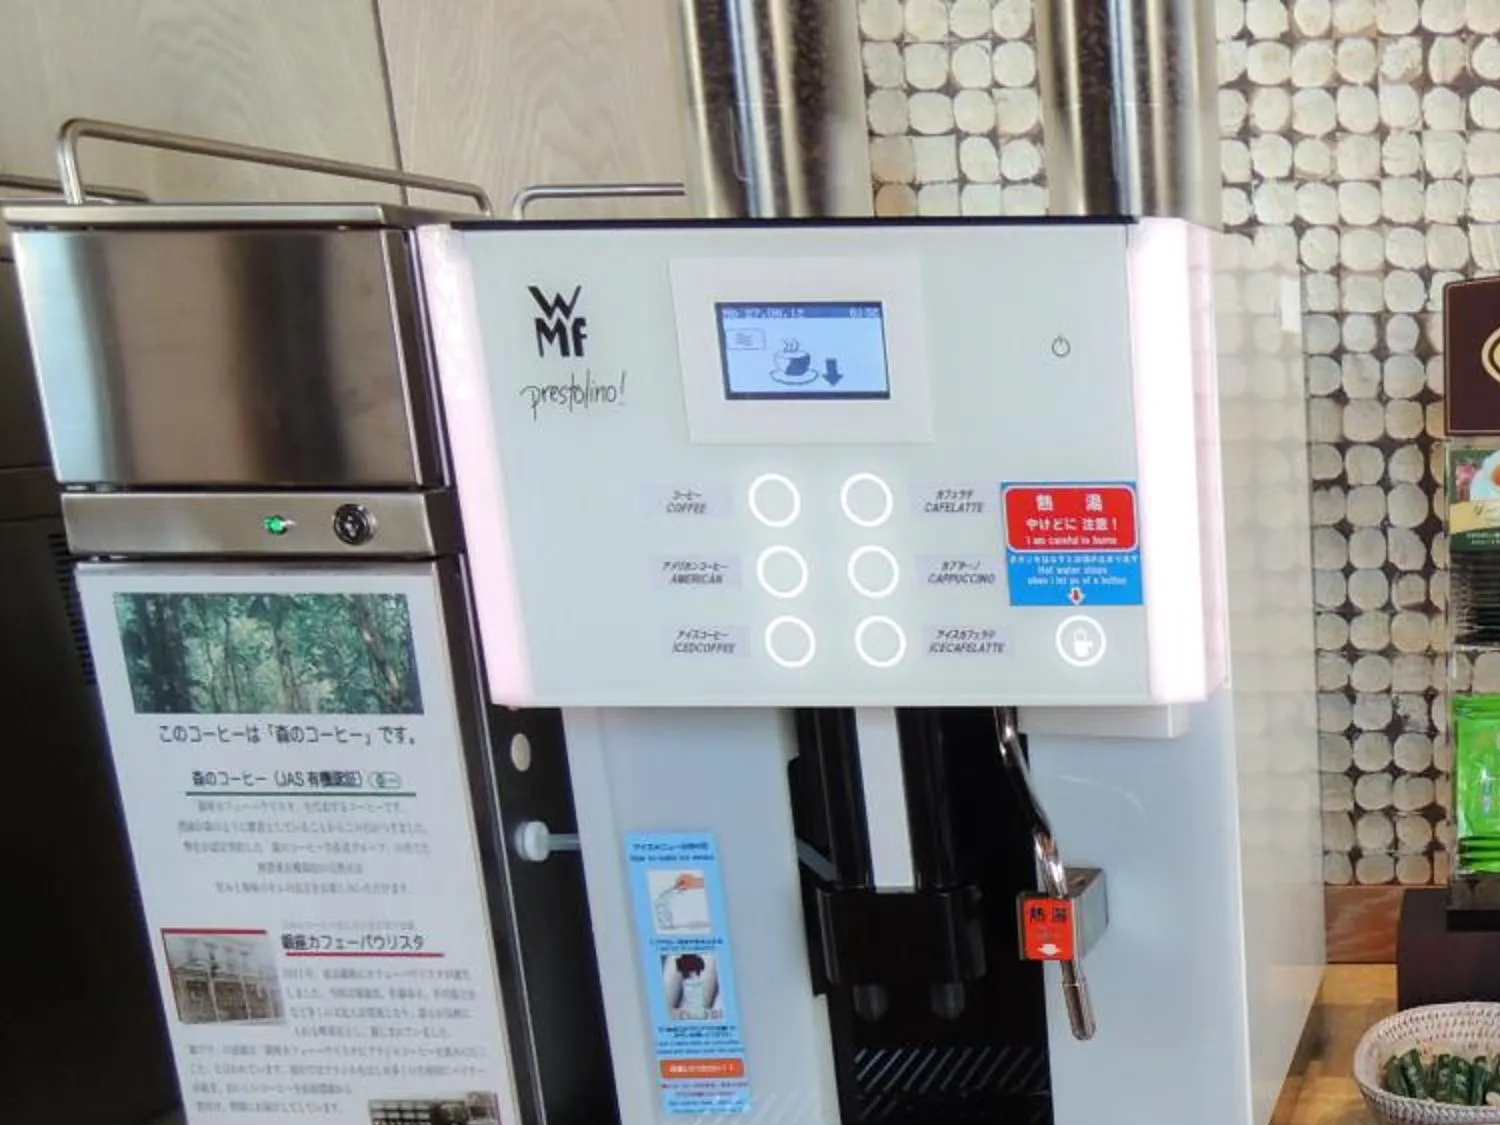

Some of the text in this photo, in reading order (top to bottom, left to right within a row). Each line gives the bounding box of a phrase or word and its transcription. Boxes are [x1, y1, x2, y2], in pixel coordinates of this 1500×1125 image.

[527, 285, 588, 358] WMF
[666, 502, 707, 514] COFFEE
[924, 502, 984, 513] CAFELATTE
[669, 573, 723, 585] AMERICAN
[927, 573, 995, 585] CAPPUCCINO
